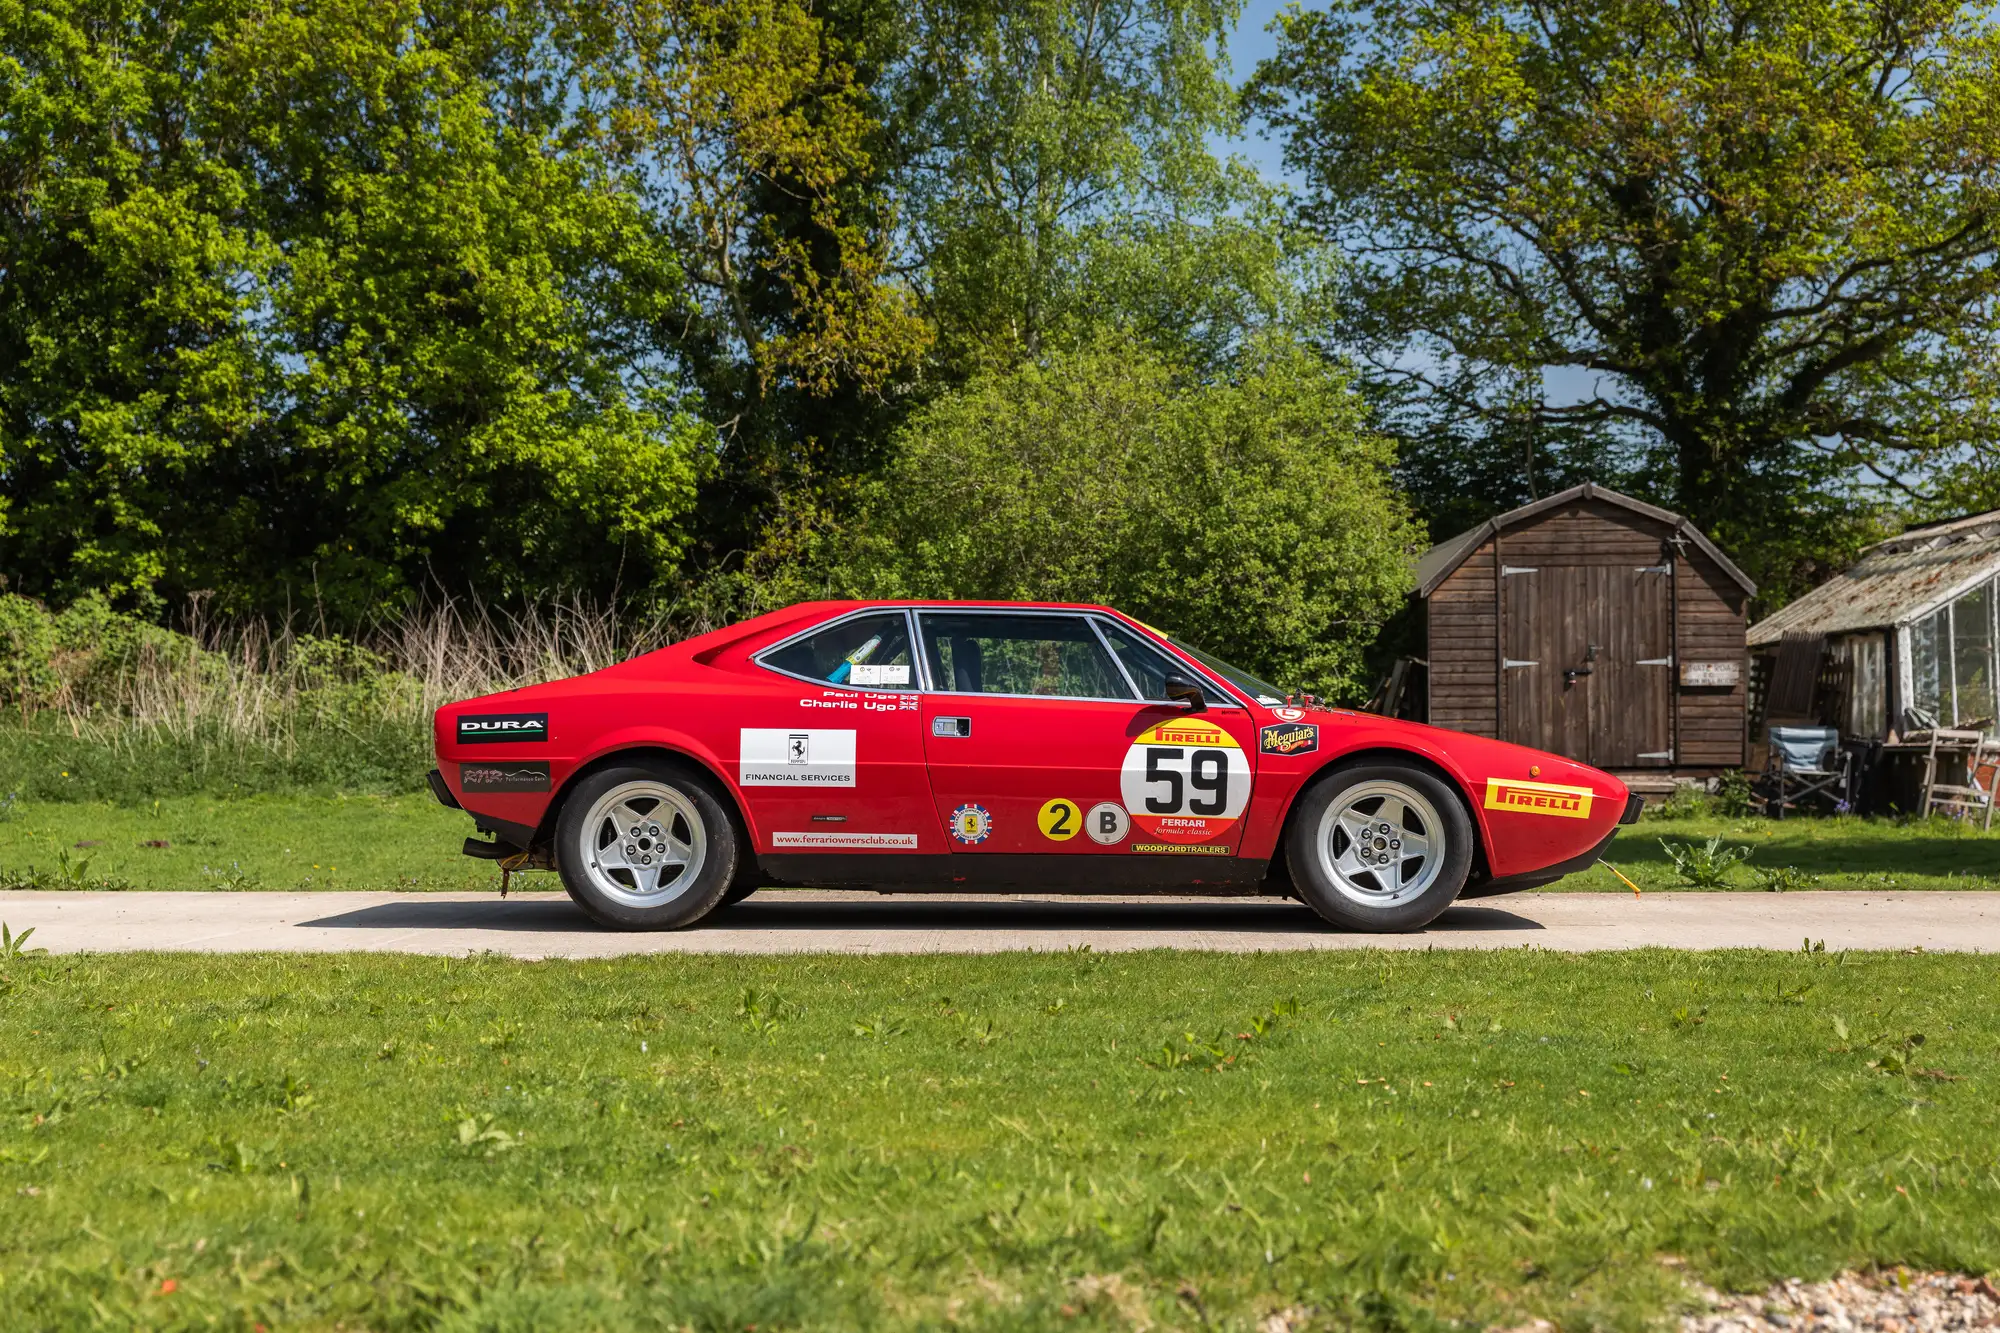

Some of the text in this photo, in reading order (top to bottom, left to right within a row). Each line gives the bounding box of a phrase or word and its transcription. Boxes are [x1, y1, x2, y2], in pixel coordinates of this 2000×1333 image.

[800, 699, 896, 711] Charlie Ugo
[461, 720, 543, 730] DURA
[1155, 727, 1221, 743] PIRELLI
[1263, 727, 1314, 752] Meguiar's
[745, 773, 851, 782] FINANCIAL SERVICES
[1145, 747, 1228, 816] 59
[1496, 785, 1582, 811] PIRELLI
[1049, 803, 1117, 834] 2 B
[1161, 818, 1206, 828] FERRARI
[1154, 826, 1212, 836] formula classic
[777, 834, 913, 846] www.ferrariownersclub.co.uk
